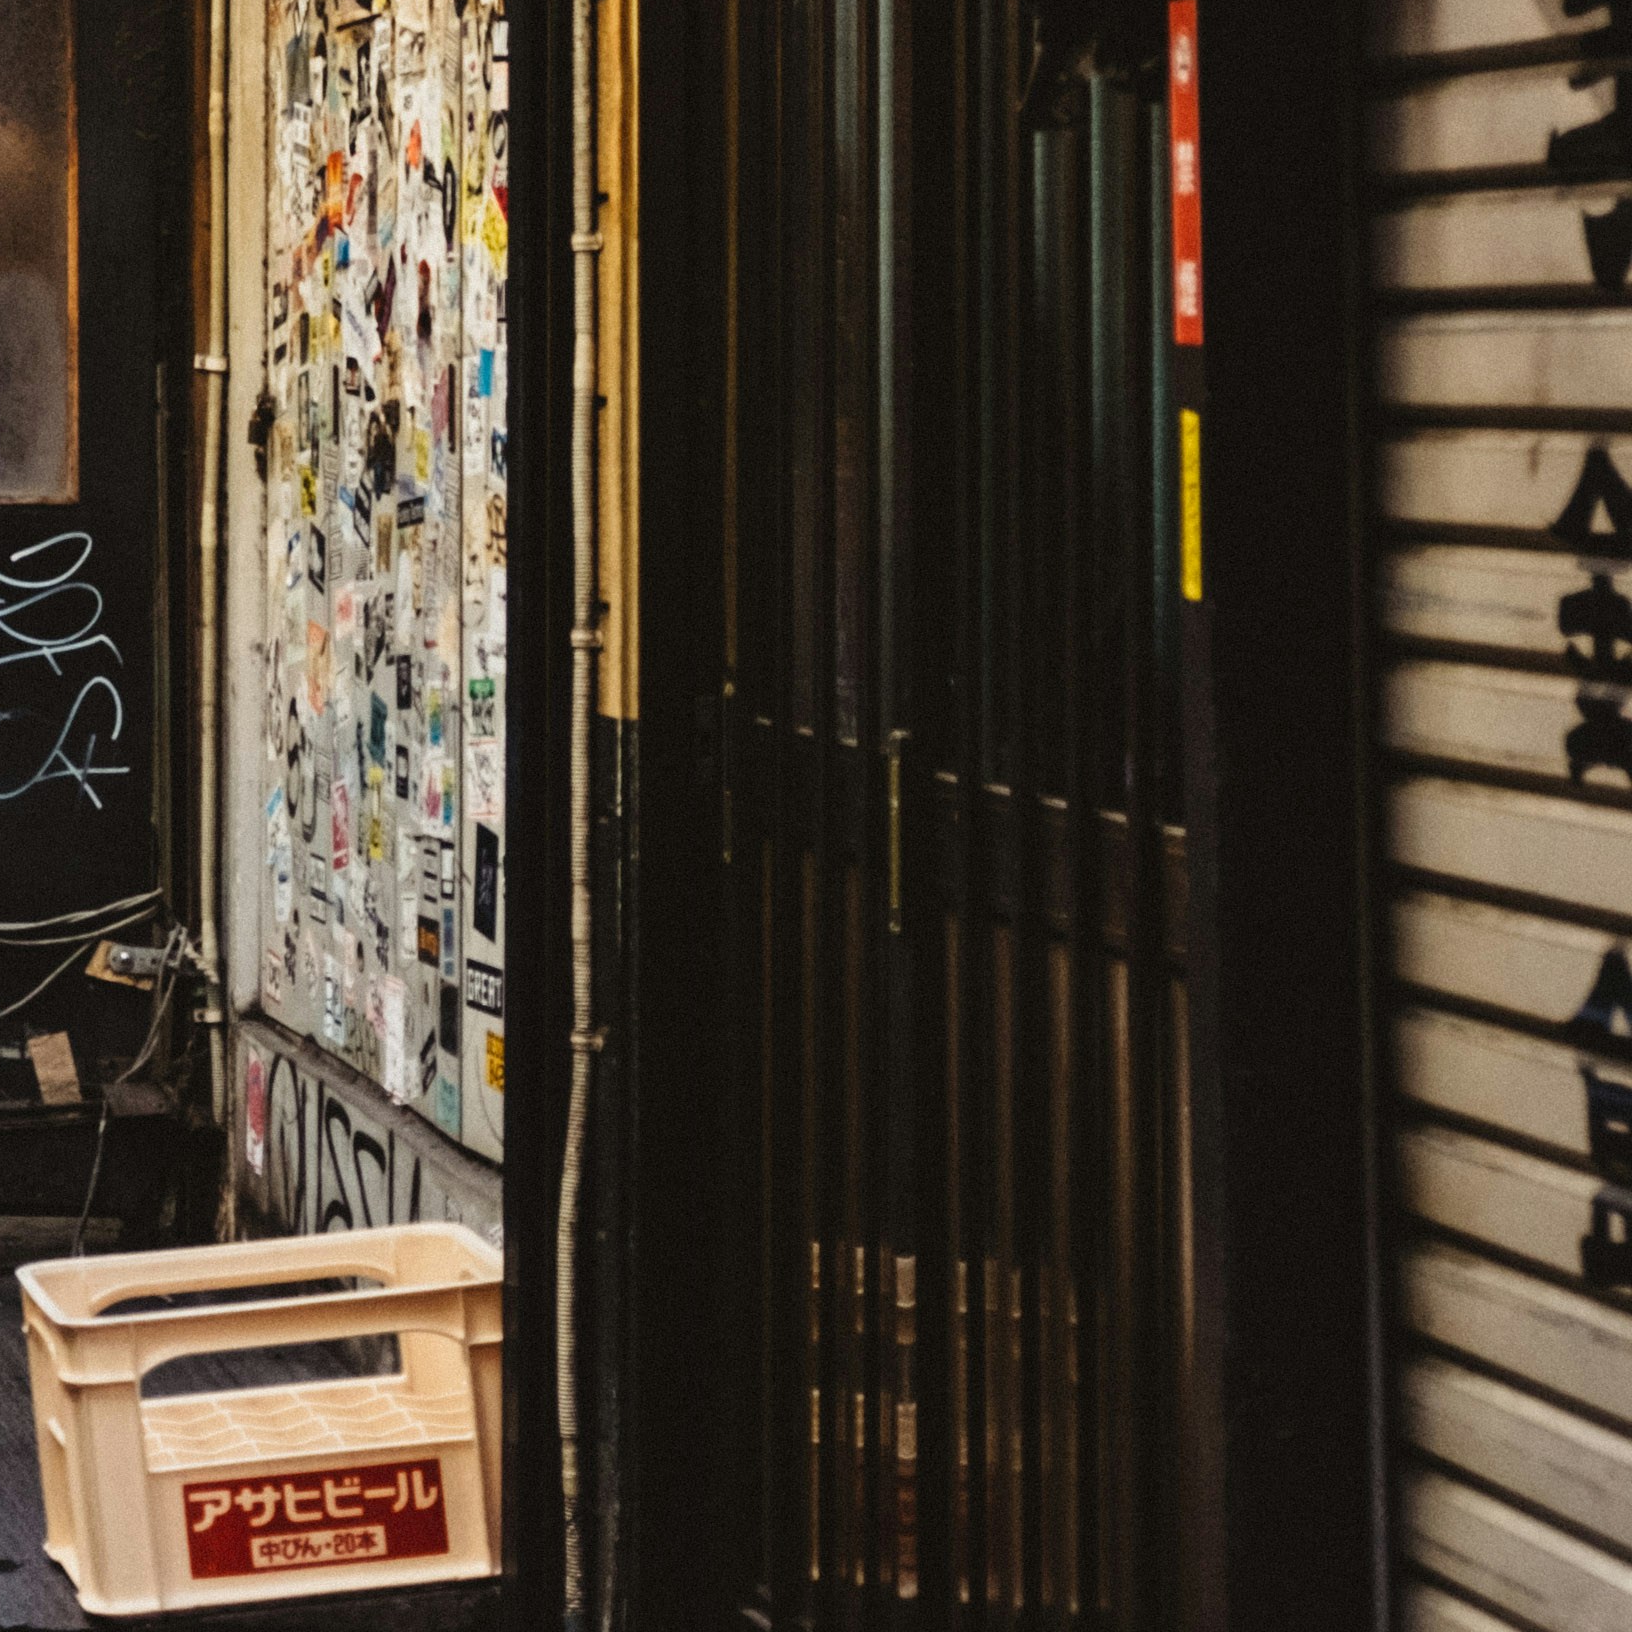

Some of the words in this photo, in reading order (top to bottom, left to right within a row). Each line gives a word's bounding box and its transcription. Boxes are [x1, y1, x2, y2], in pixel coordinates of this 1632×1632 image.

[188, 1469, 437, 1533] アサヒビール
